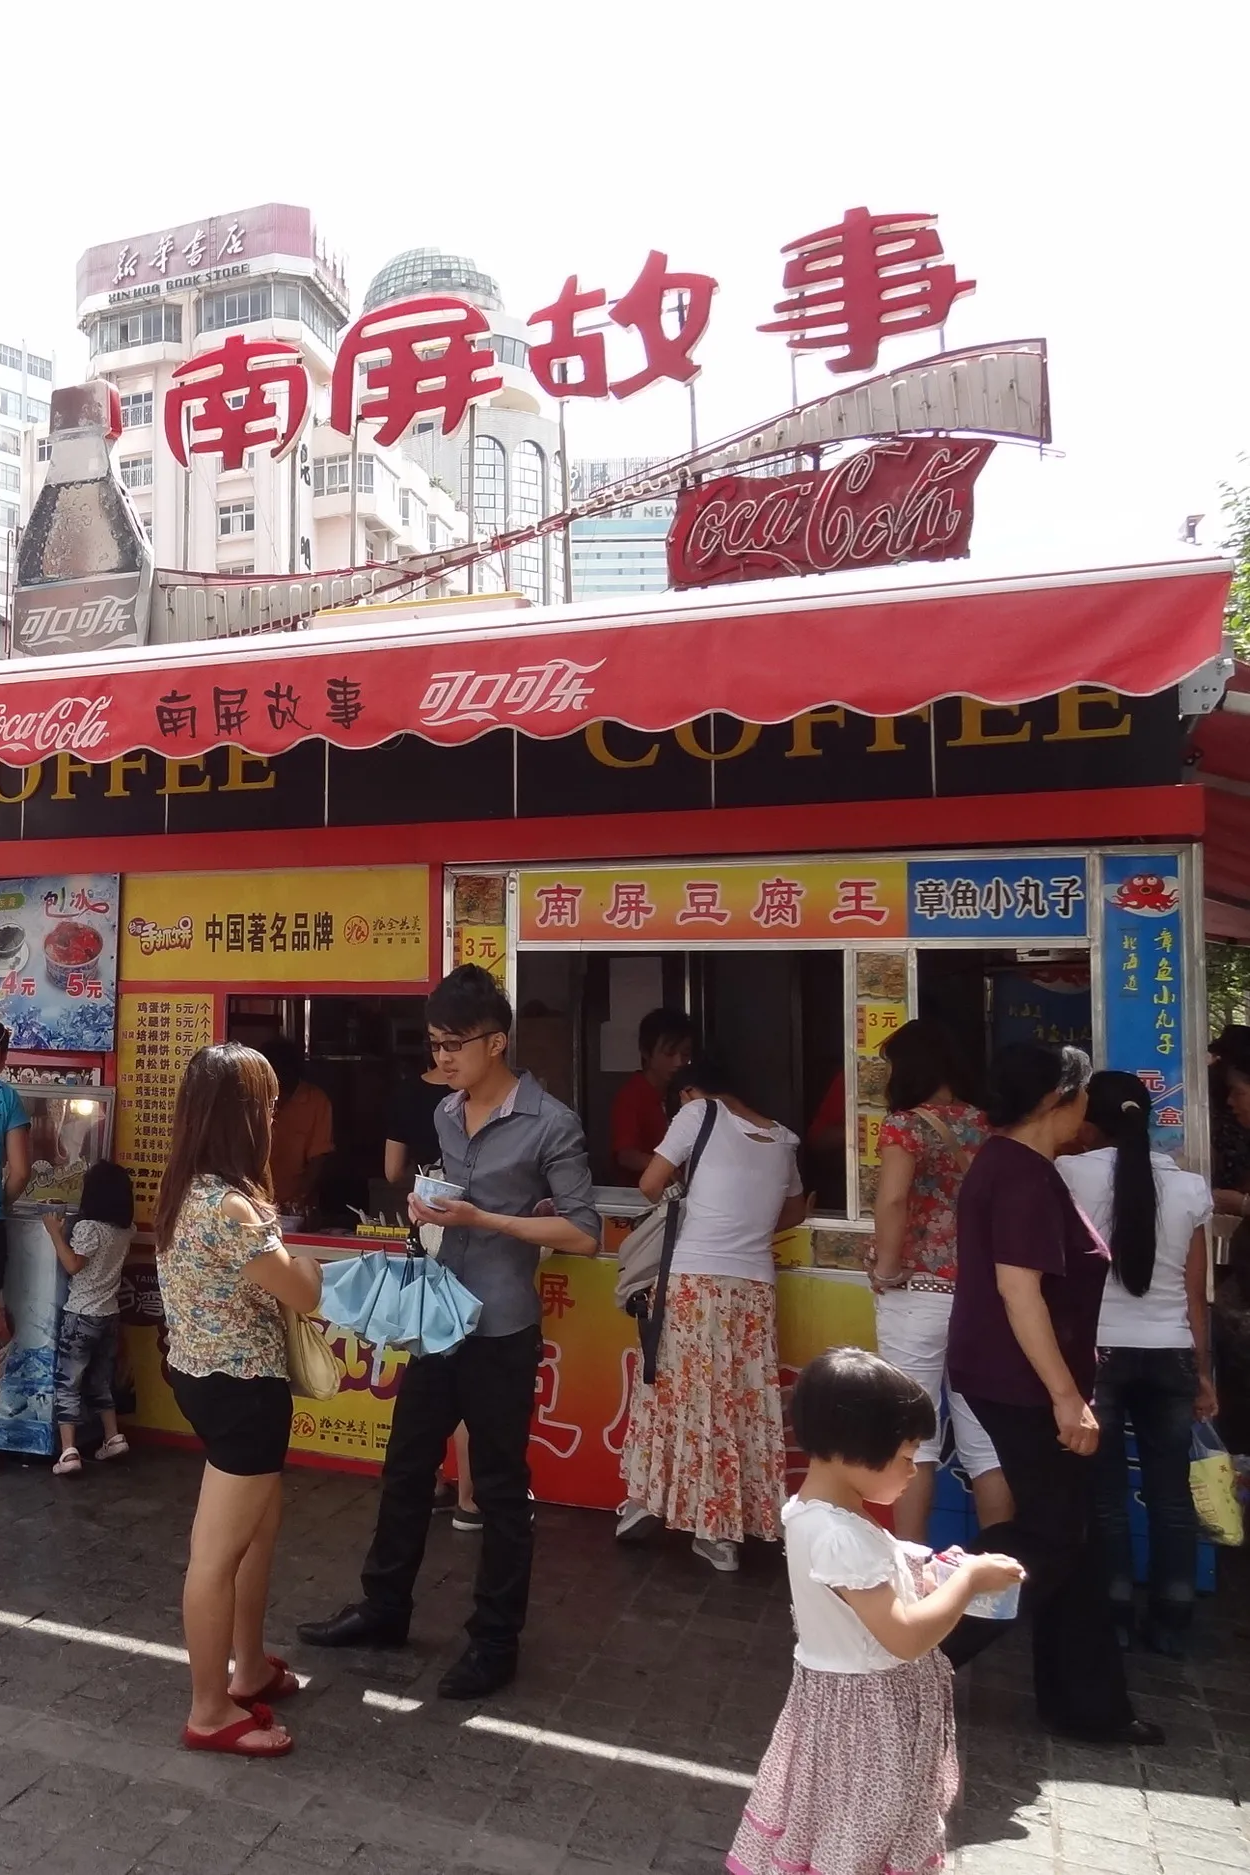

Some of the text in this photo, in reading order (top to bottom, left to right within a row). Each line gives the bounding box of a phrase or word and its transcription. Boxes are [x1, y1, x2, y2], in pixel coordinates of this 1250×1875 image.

[205, 263, 249, 282] STORE
[163, 206, 978, 472] 南屏故事
[670, 438, 982, 588] Coca-Cola
[19, 594, 138, 647] 可口可乐
[155, 676, 366, 740] 南屏故事
[417, 656, 608, 729] 可口可乐
[584, 687, 1133, 769] COFFEE
[534, 875, 1087, 927] 南屏豆腐王 章魚小丸子
[139, 915, 193, 955] 手抓饼
[204, 912, 335, 952] 中国著名品牌
[465, 936, 497, 959] 3元
[1, 970, 36, 996] 4元
[66, 972, 103, 999] 5元
[137, 1002, 211, 1014] 鸡蛋饼 5元/个
[868, 1012, 898, 1028] 3元
[136, 1016, 211, 1029] 火腿饼 5元/个
[175, 1031, 211, 1043] 6元/个
